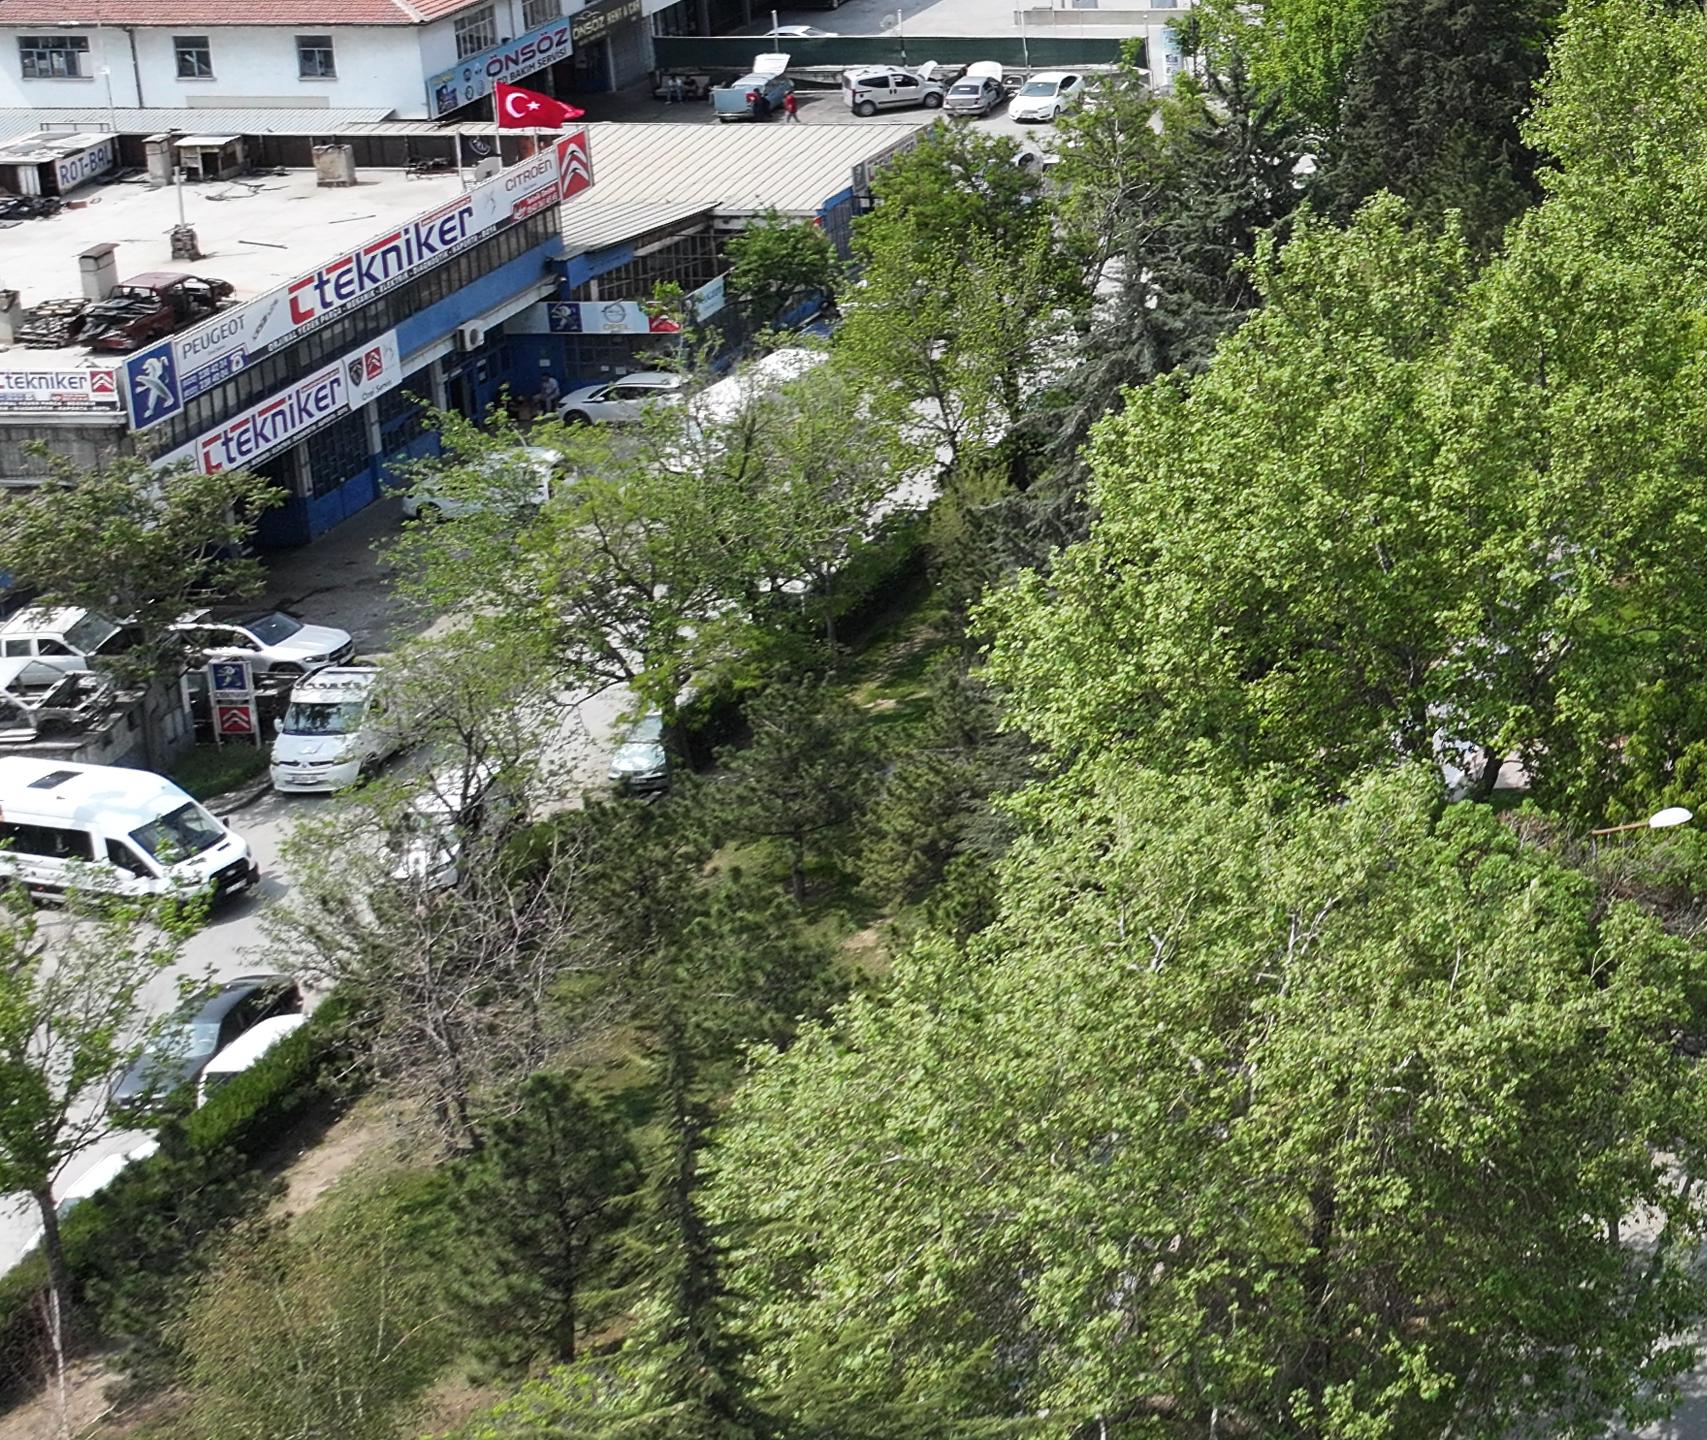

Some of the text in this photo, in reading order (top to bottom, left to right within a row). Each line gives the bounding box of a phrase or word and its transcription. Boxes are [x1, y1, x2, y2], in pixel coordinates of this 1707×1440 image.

[485, 26, 569, 78] ÖNSÖZ
[509, 62, 537, 82] BAKIM
[313, 205, 474, 310] tekniker
[182, 314, 247, 360] PEUGEOT
[5, 372, 88, 390] tekniker
[221, 377, 342, 465] tekniker
